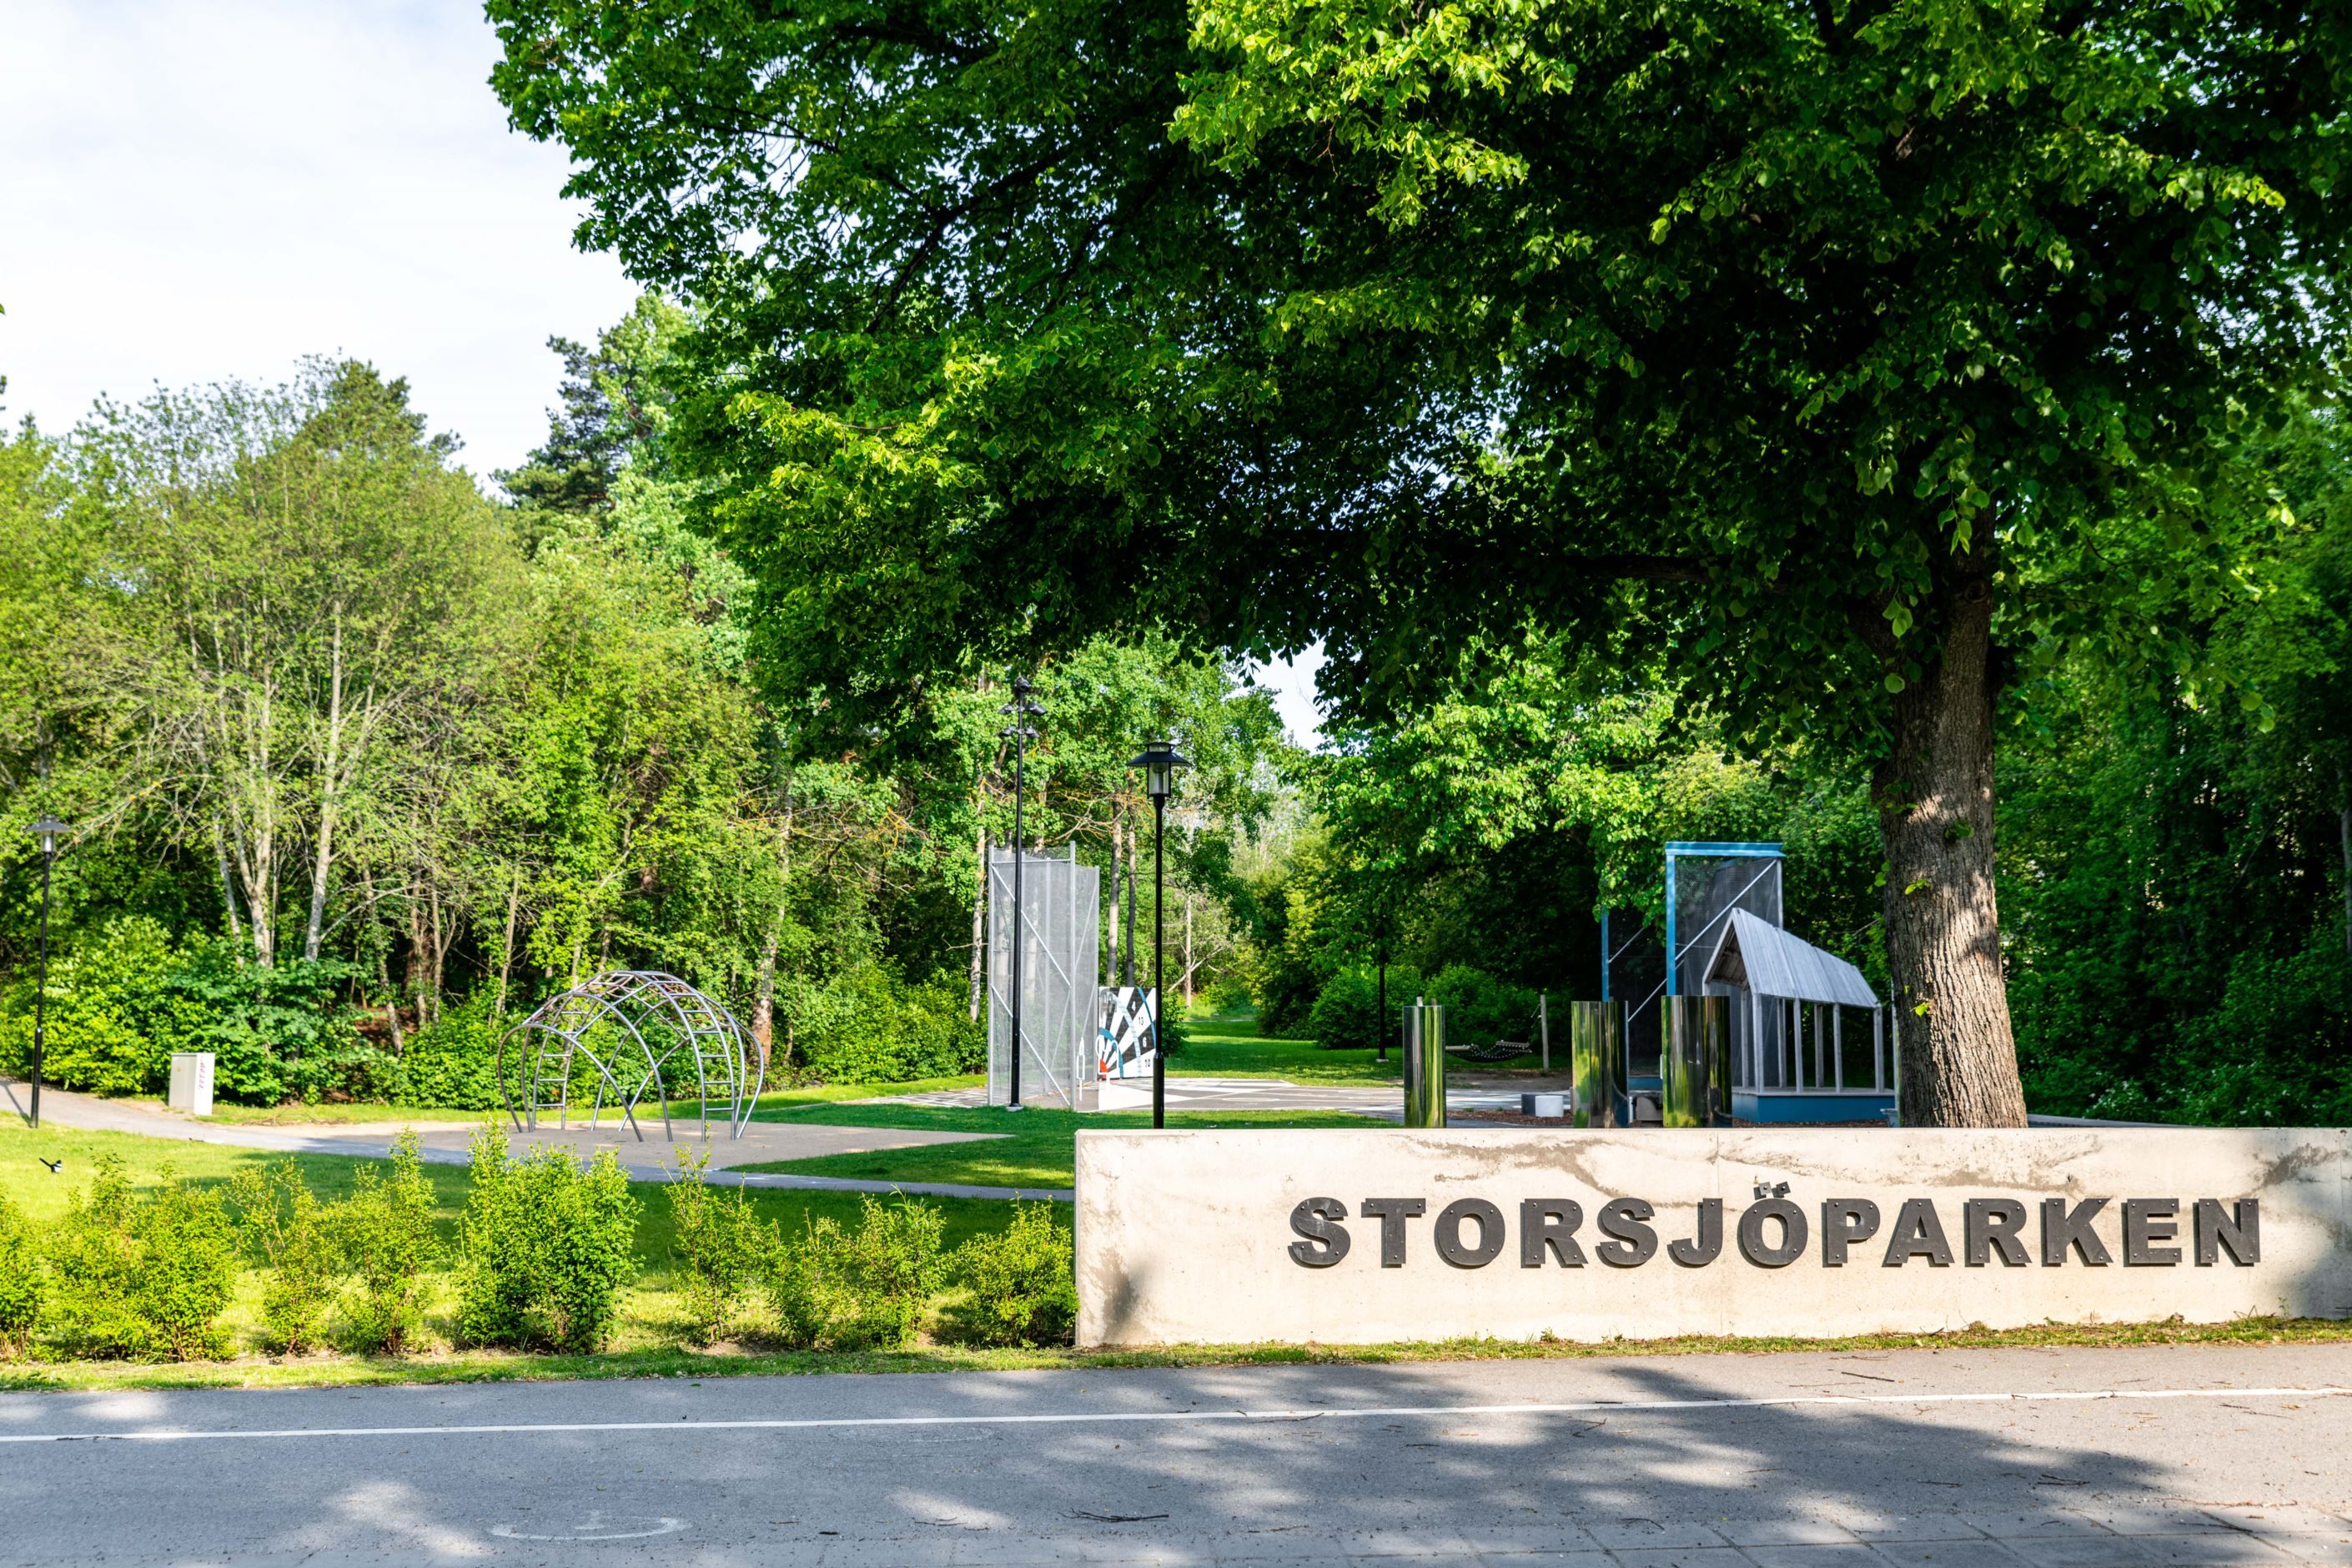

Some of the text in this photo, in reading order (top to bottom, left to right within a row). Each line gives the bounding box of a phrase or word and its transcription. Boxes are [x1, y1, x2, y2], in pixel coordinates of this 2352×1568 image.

[1131, 1000, 1136, 1012] 4
[1138, 1016, 1144, 1026] 13
[1144, 1058, 1150, 1068] 10
[1288, 1181, 2260, 1269] STORSJÖPARKEN
